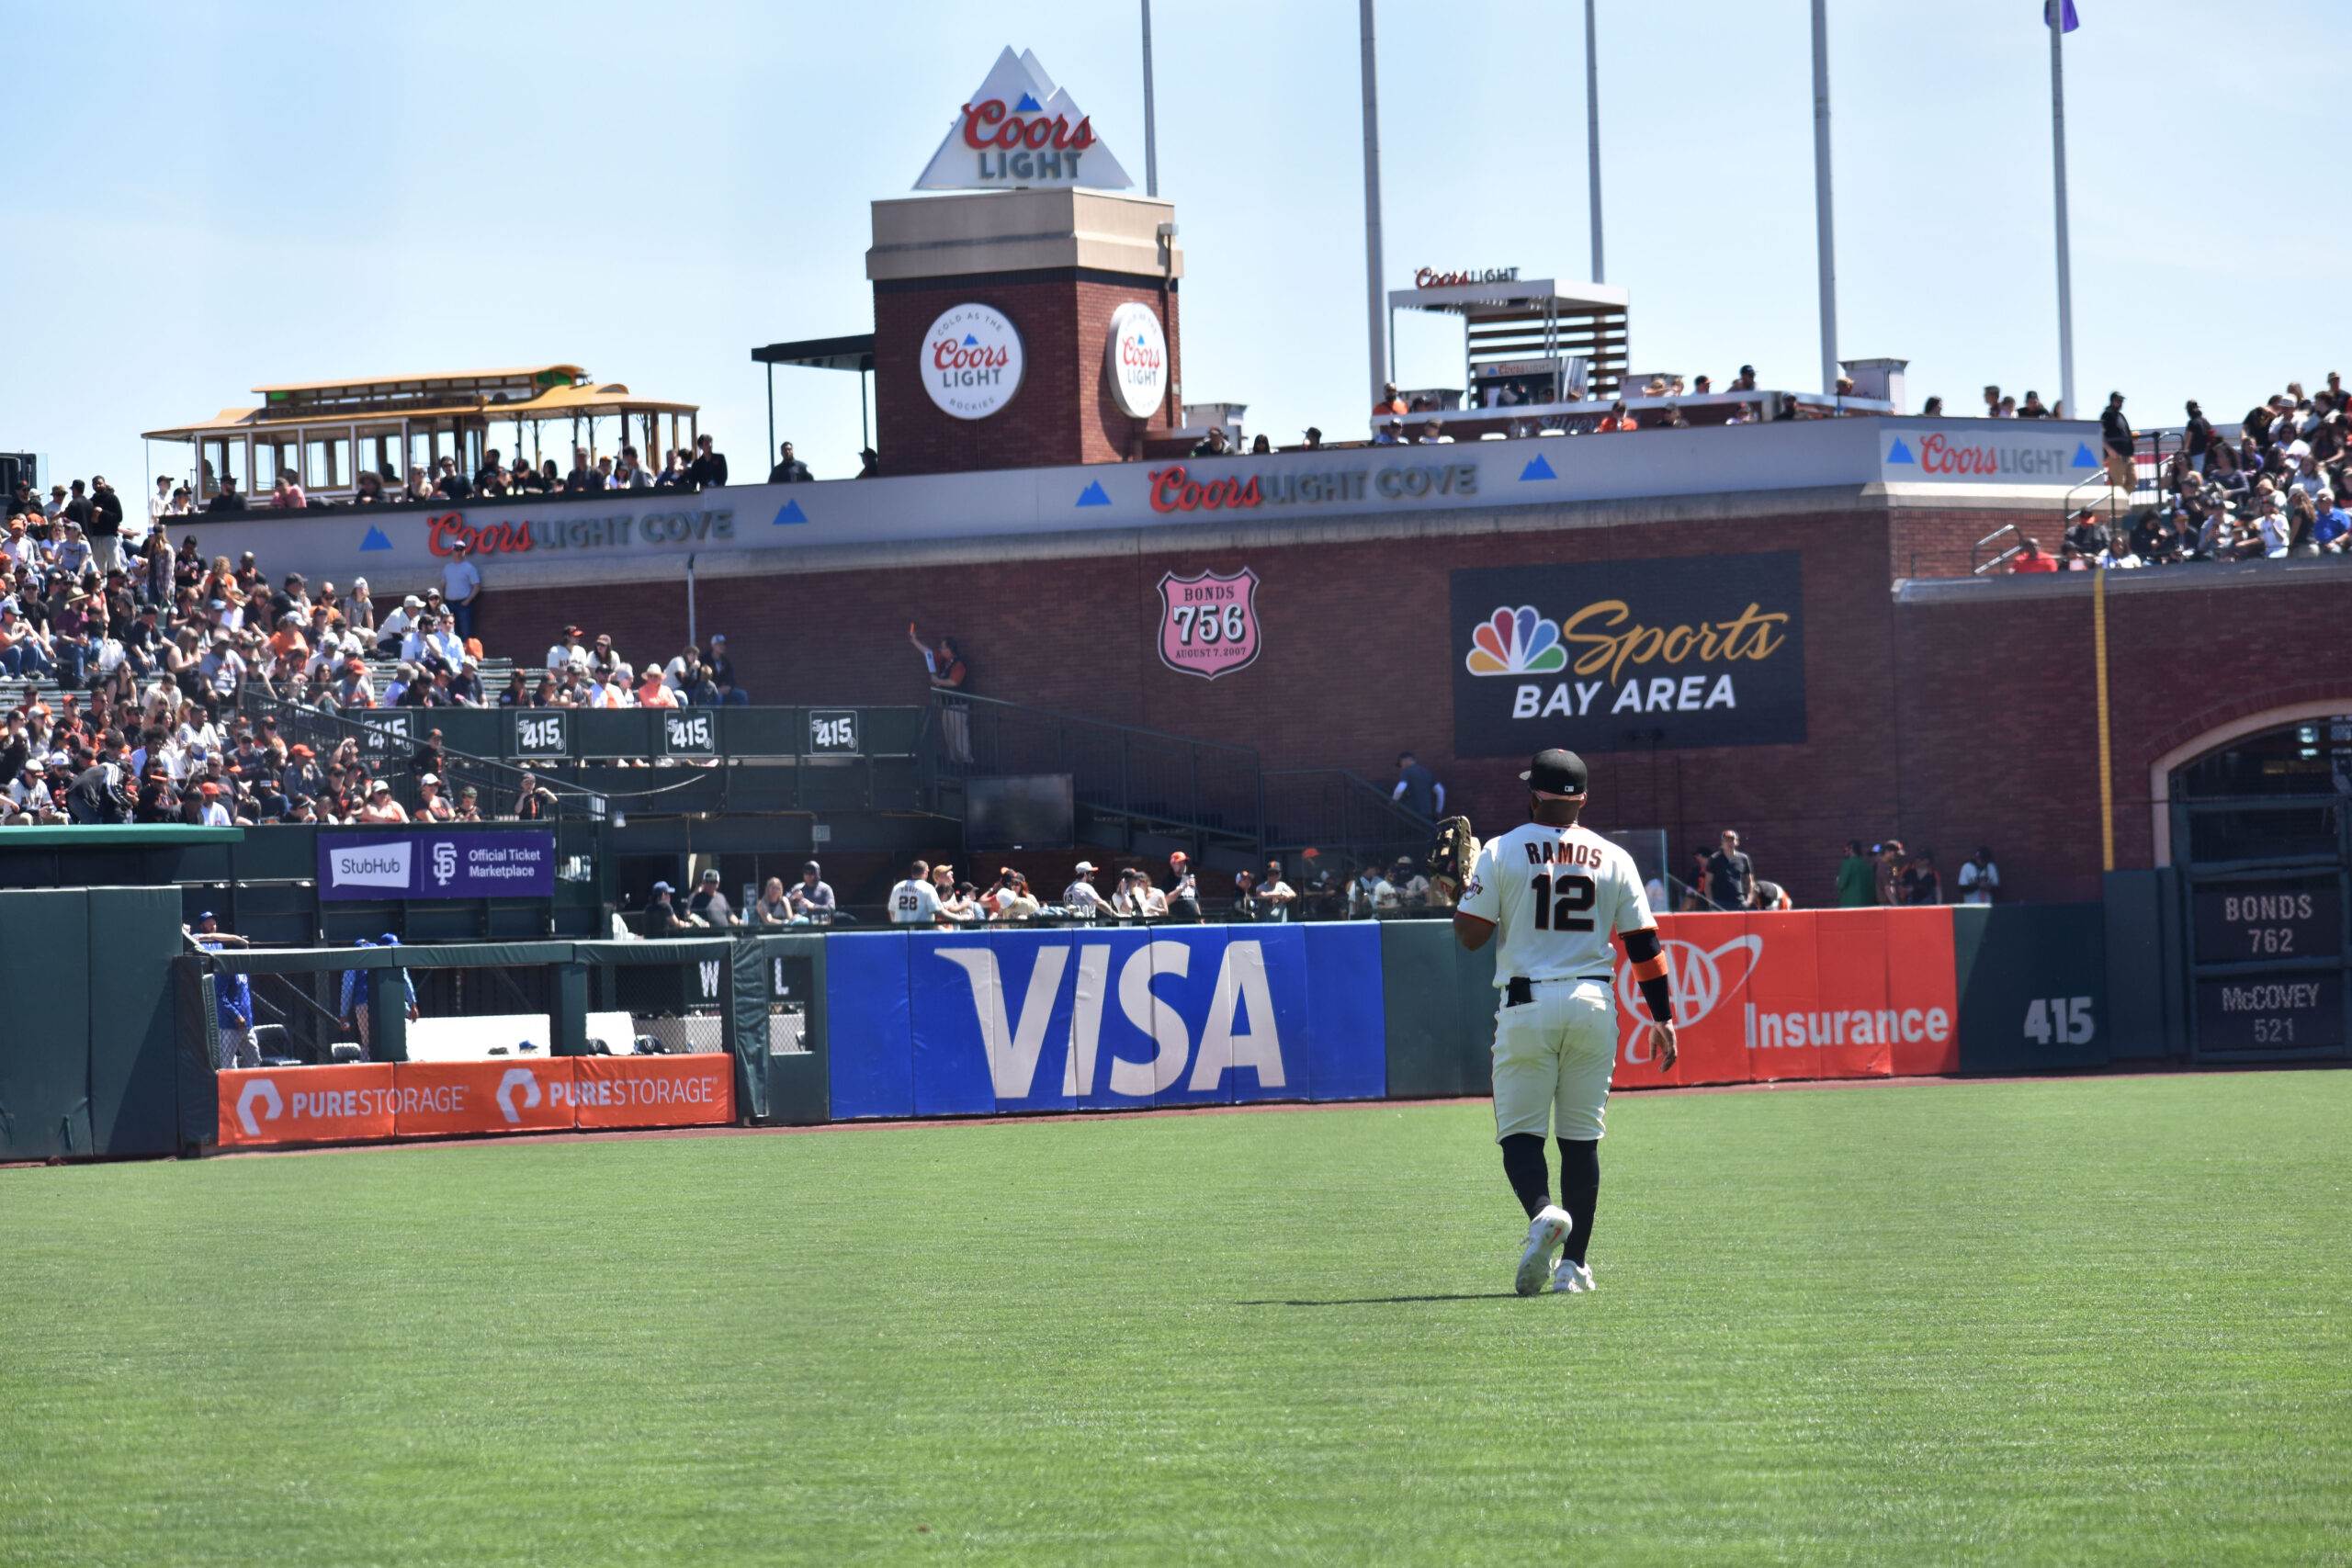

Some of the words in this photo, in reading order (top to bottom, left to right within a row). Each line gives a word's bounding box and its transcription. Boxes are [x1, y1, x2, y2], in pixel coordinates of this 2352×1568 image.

[962, 99, 1096, 150] Coors
[979, 152, 1083, 179] LIGHT
[1415, 266, 1468, 289] Coors
[1470, 267, 1520, 284] LIGHT
[937, 315, 962, 336] COLD
[967, 312, 980, 321] AS
[985, 316, 1002, 333] THE
[933, 338, 1009, 370] Coors
[1122, 336, 1160, 369] Coors
[943, 368, 1001, 388] LIGHT
[1126, 368, 1157, 386] LIGHT
[949, 396, 995, 412] ROCKIES
[1920, 433, 1998, 475] Coors
[2000, 448, 2065, 475] LIGHT
[1148, 465, 1263, 513] Coors
[1261, 469, 1368, 505] LIGHT
[1376, 464, 1478, 499] COVE
[426, 511, 534, 557] Coors
[531, 515, 632, 550] LIGHT
[639, 509, 734, 544] COVE
[1184, 586, 1235, 602] BONDS
[1173, 603, 1246, 646] 756
[1176, 648, 1212, 659] AUGUST
[1213, 648, 1223, 658] 7,
[1224, 647, 1247, 657] 2007
[1564, 599, 1790, 687] Sports
[1512, 682, 1603, 719] BAY
[1611, 674, 1736, 715] AREA
[522, 718, 560, 749] 415
[671, 717, 707, 748] 415
[816, 717, 853, 748] 415
[341, 858, 401, 874] StubHub
[469, 849, 506, 862] Official
[508, 849, 541, 862] Ticket
[1524, 840, 1602, 869] RAMOS
[469, 865, 535, 879] Marketplace
[899, 895, 918, 910] 28
[1532, 873, 1596, 931] 12
[2224, 895, 2312, 921] BONDS
[2248, 929, 2293, 953] 762
[699, 960, 719, 998] W
[775, 958, 789, 995] L
[2222, 983, 2320, 1012] McCOVEY
[934, 940, 1286, 1099] VISA
[1745, 1003, 1949, 1049] Insurance
[2024, 996, 2095, 1045] 415
[2255, 1018, 2293, 1043] 521
